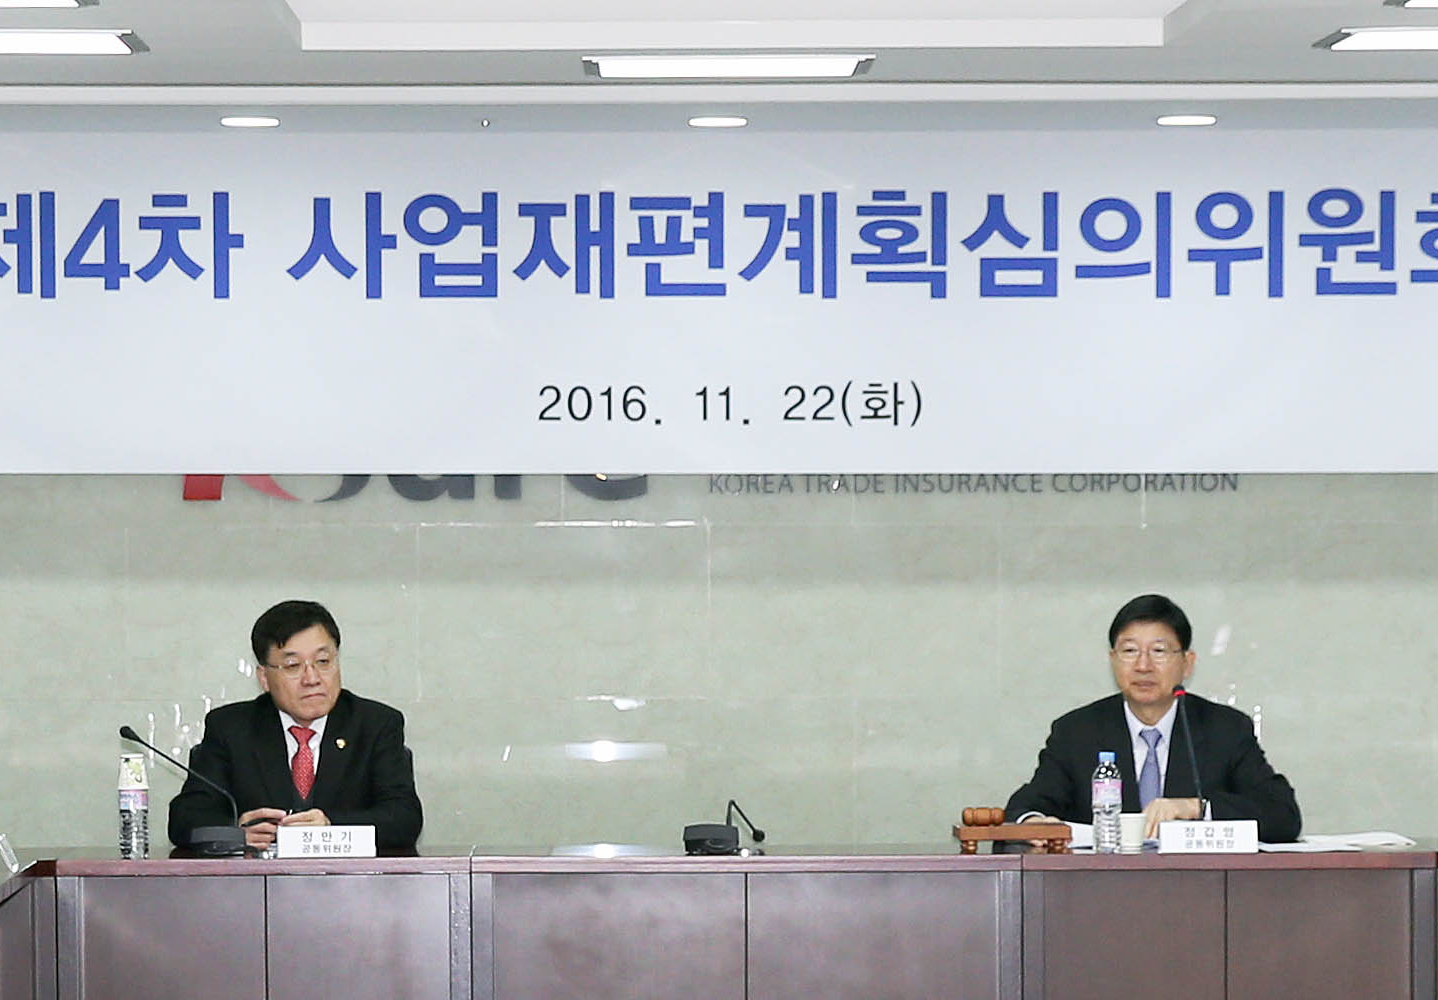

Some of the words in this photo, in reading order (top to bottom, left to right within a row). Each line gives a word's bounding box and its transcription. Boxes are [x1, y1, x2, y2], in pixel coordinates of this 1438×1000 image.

[538, 385, 663, 425] 2016.
[695, 386, 750, 425] 11.
[783, 380, 923, 427] 22(화)
[707, 474, 794, 494] KOREA
[803, 474, 886, 494] TRADE
[895, 474, 1044, 494] INSURANCE
[1052, 474, 1239, 493] CORPORATION
